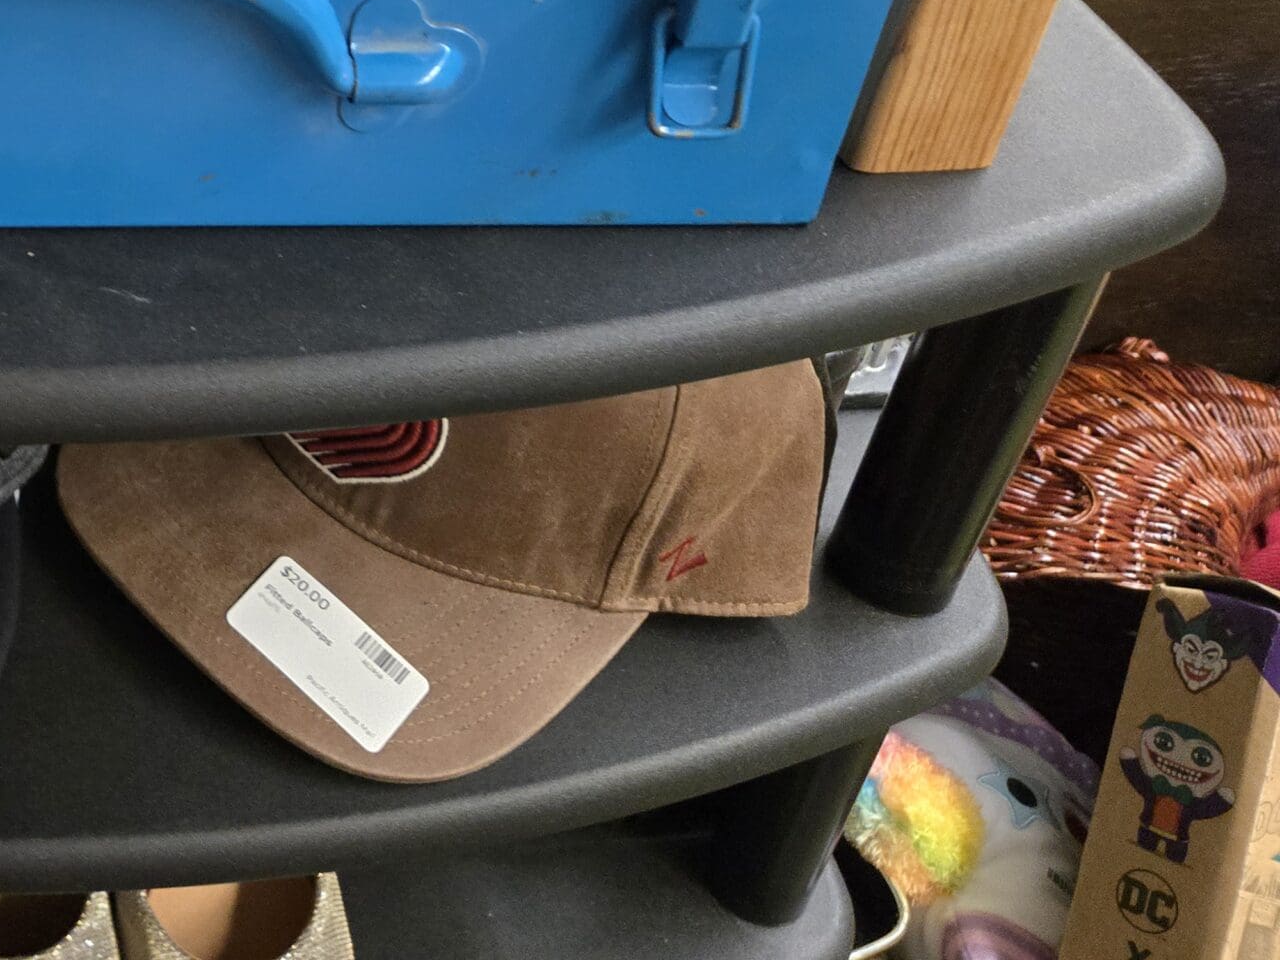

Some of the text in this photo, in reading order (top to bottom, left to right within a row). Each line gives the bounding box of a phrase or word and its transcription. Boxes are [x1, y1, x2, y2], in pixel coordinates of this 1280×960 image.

[264, 583, 293, 612] Fitted
[293, 608, 334, 647] Ballcaps
[280, 565, 330, 611] $20.00
[1120, 872, 1175, 930] DC
